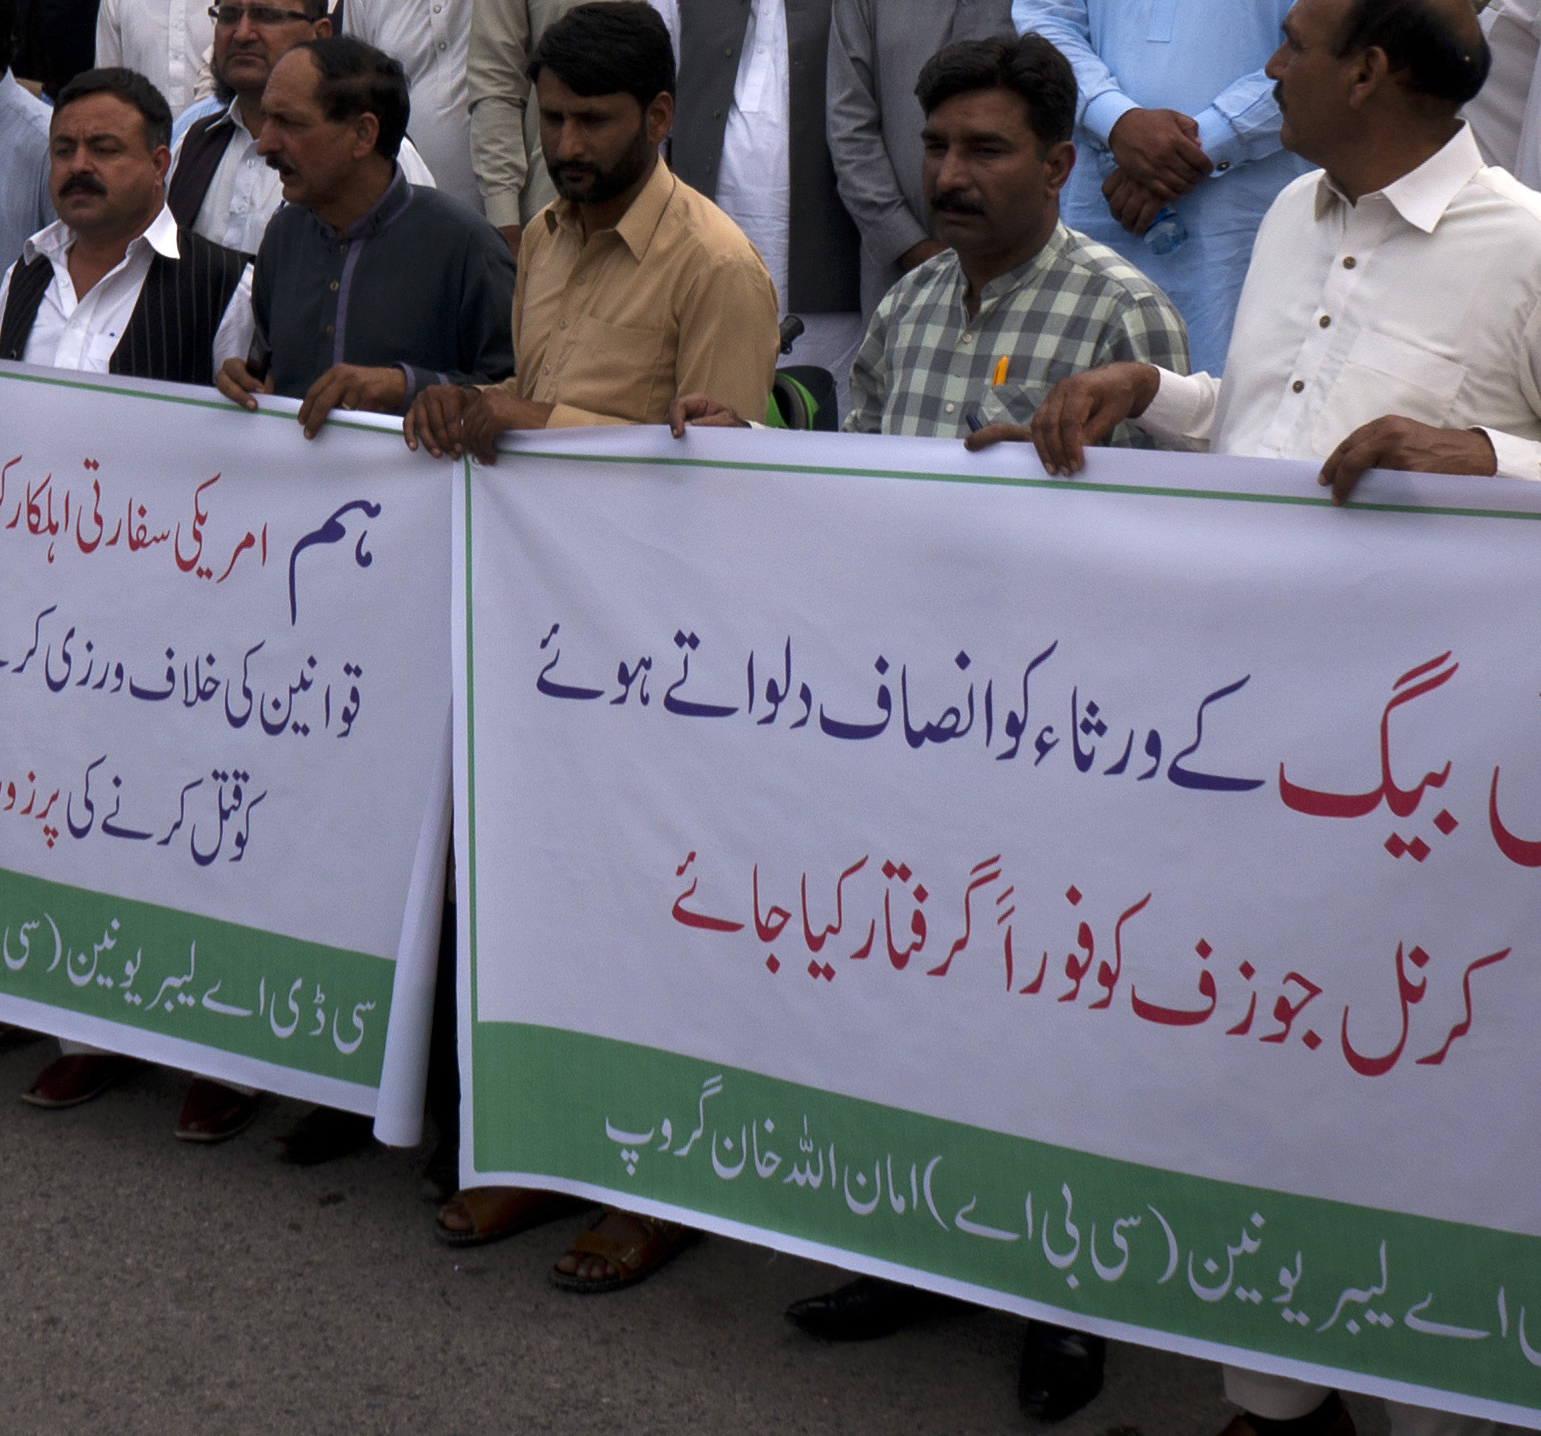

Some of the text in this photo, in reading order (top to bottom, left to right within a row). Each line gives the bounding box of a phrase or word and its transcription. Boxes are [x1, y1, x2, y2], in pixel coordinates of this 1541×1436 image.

[75, 458, 171, 555] سفارتی
[288, 499, 382, 626] ہم
[44, 626, 125, 693] ورزی
[129, 647, 221, 708] خلاف
[224, 640, 265, 729] کی
[535, 623, 653, 707] ہوئے
[819, 650, 994, 749] انصاف
[995, 640, 1058, 761] کو
[1167, 674, 1266, 792] کے
[1278, 650, 1460, 863] بیگ
[66, 755, 107, 840] کی
[101, 775, 204, 846] کرنے
[190, 768, 250, 867] قتل
[671, 851, 792, 975] جائے
[800, 855, 869, 983] کیا
[849, 854, 1002, 977] گرفتار
[1088, 892, 1152, 1010] کو
[201, 978, 266, 1017] اے
[332, 1001, 376, 1053] سی
[1131, 938, 1323, 1051] جوزف
[1341, 941, 1512, 1077] کرنل
[1404, 1287, 1508, 1340] اے
